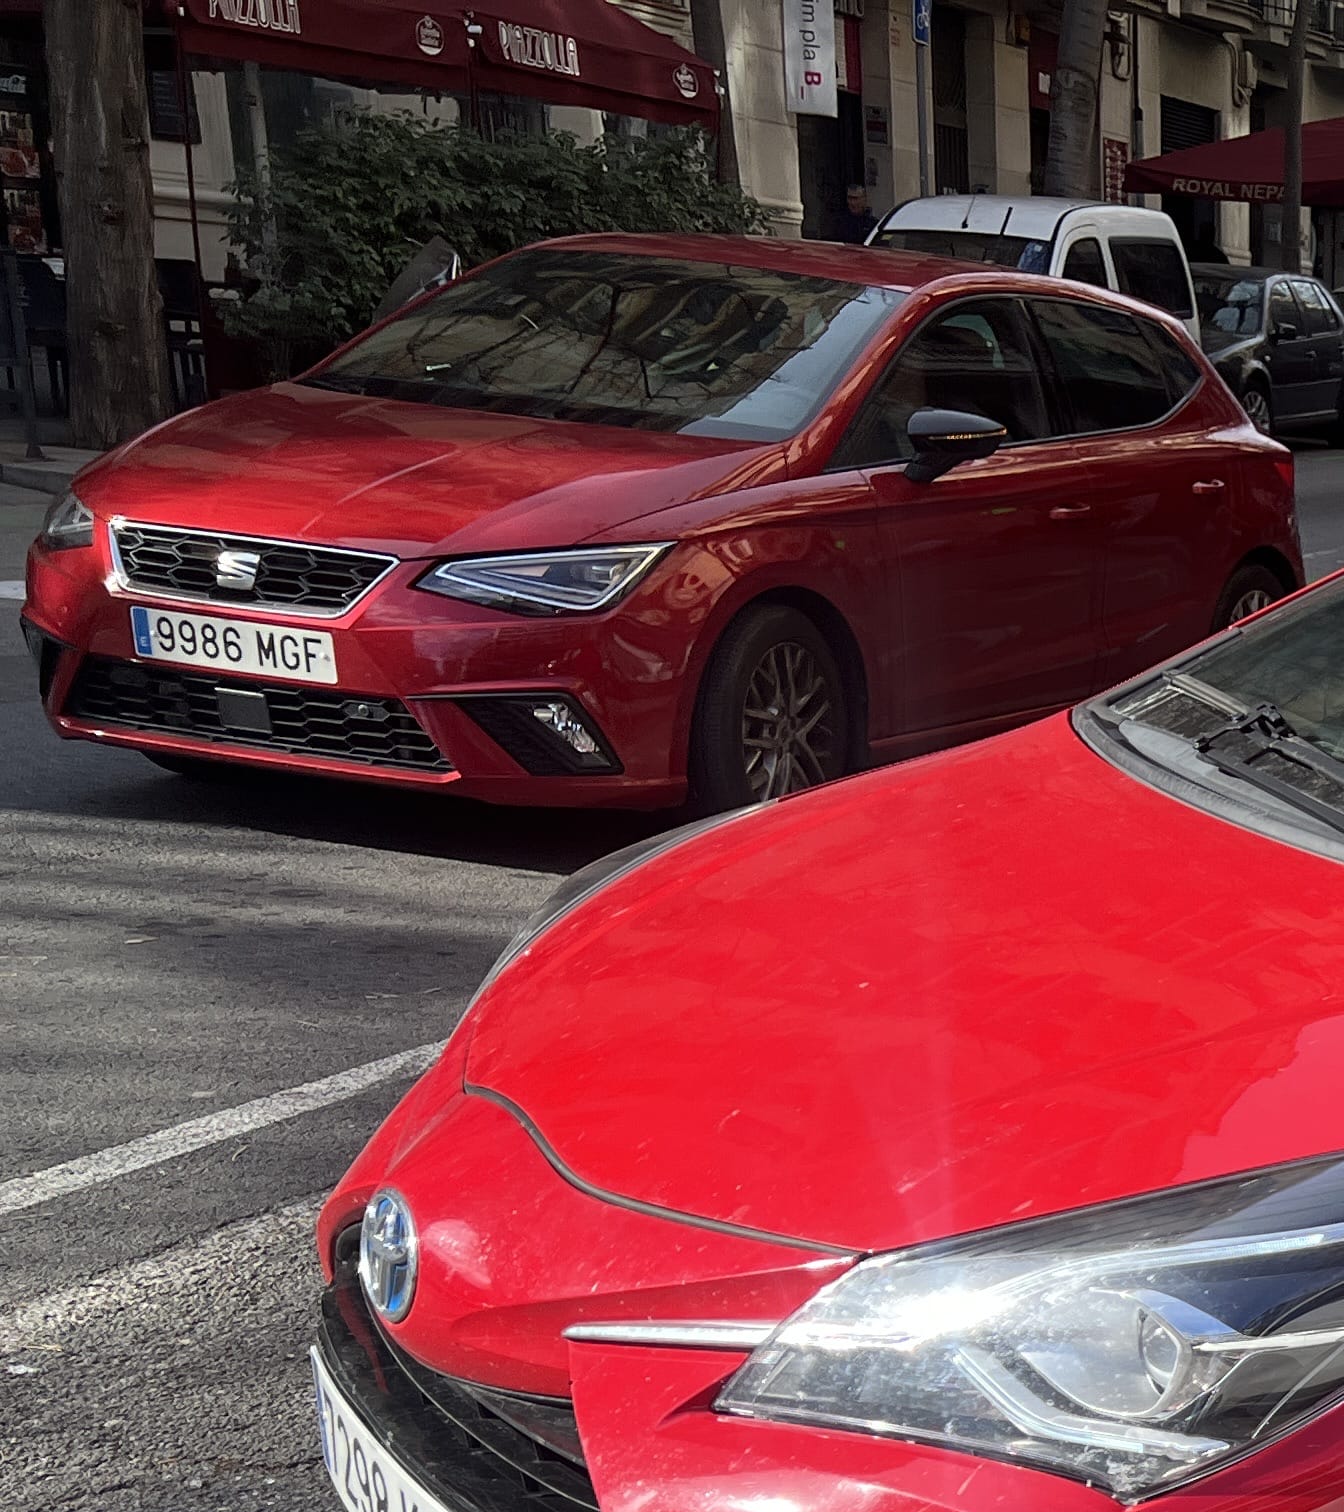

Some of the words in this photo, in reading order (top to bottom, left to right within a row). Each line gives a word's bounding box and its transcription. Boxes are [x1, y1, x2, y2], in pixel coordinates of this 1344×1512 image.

[498, 20, 580, 76] PIAZZOLLA
[799, 30, 820, 60] pla
[1172, 177, 1235, 199] ROYAL
[156, 616, 243, 662] 9986
[255, 630, 322, 673] MGF
